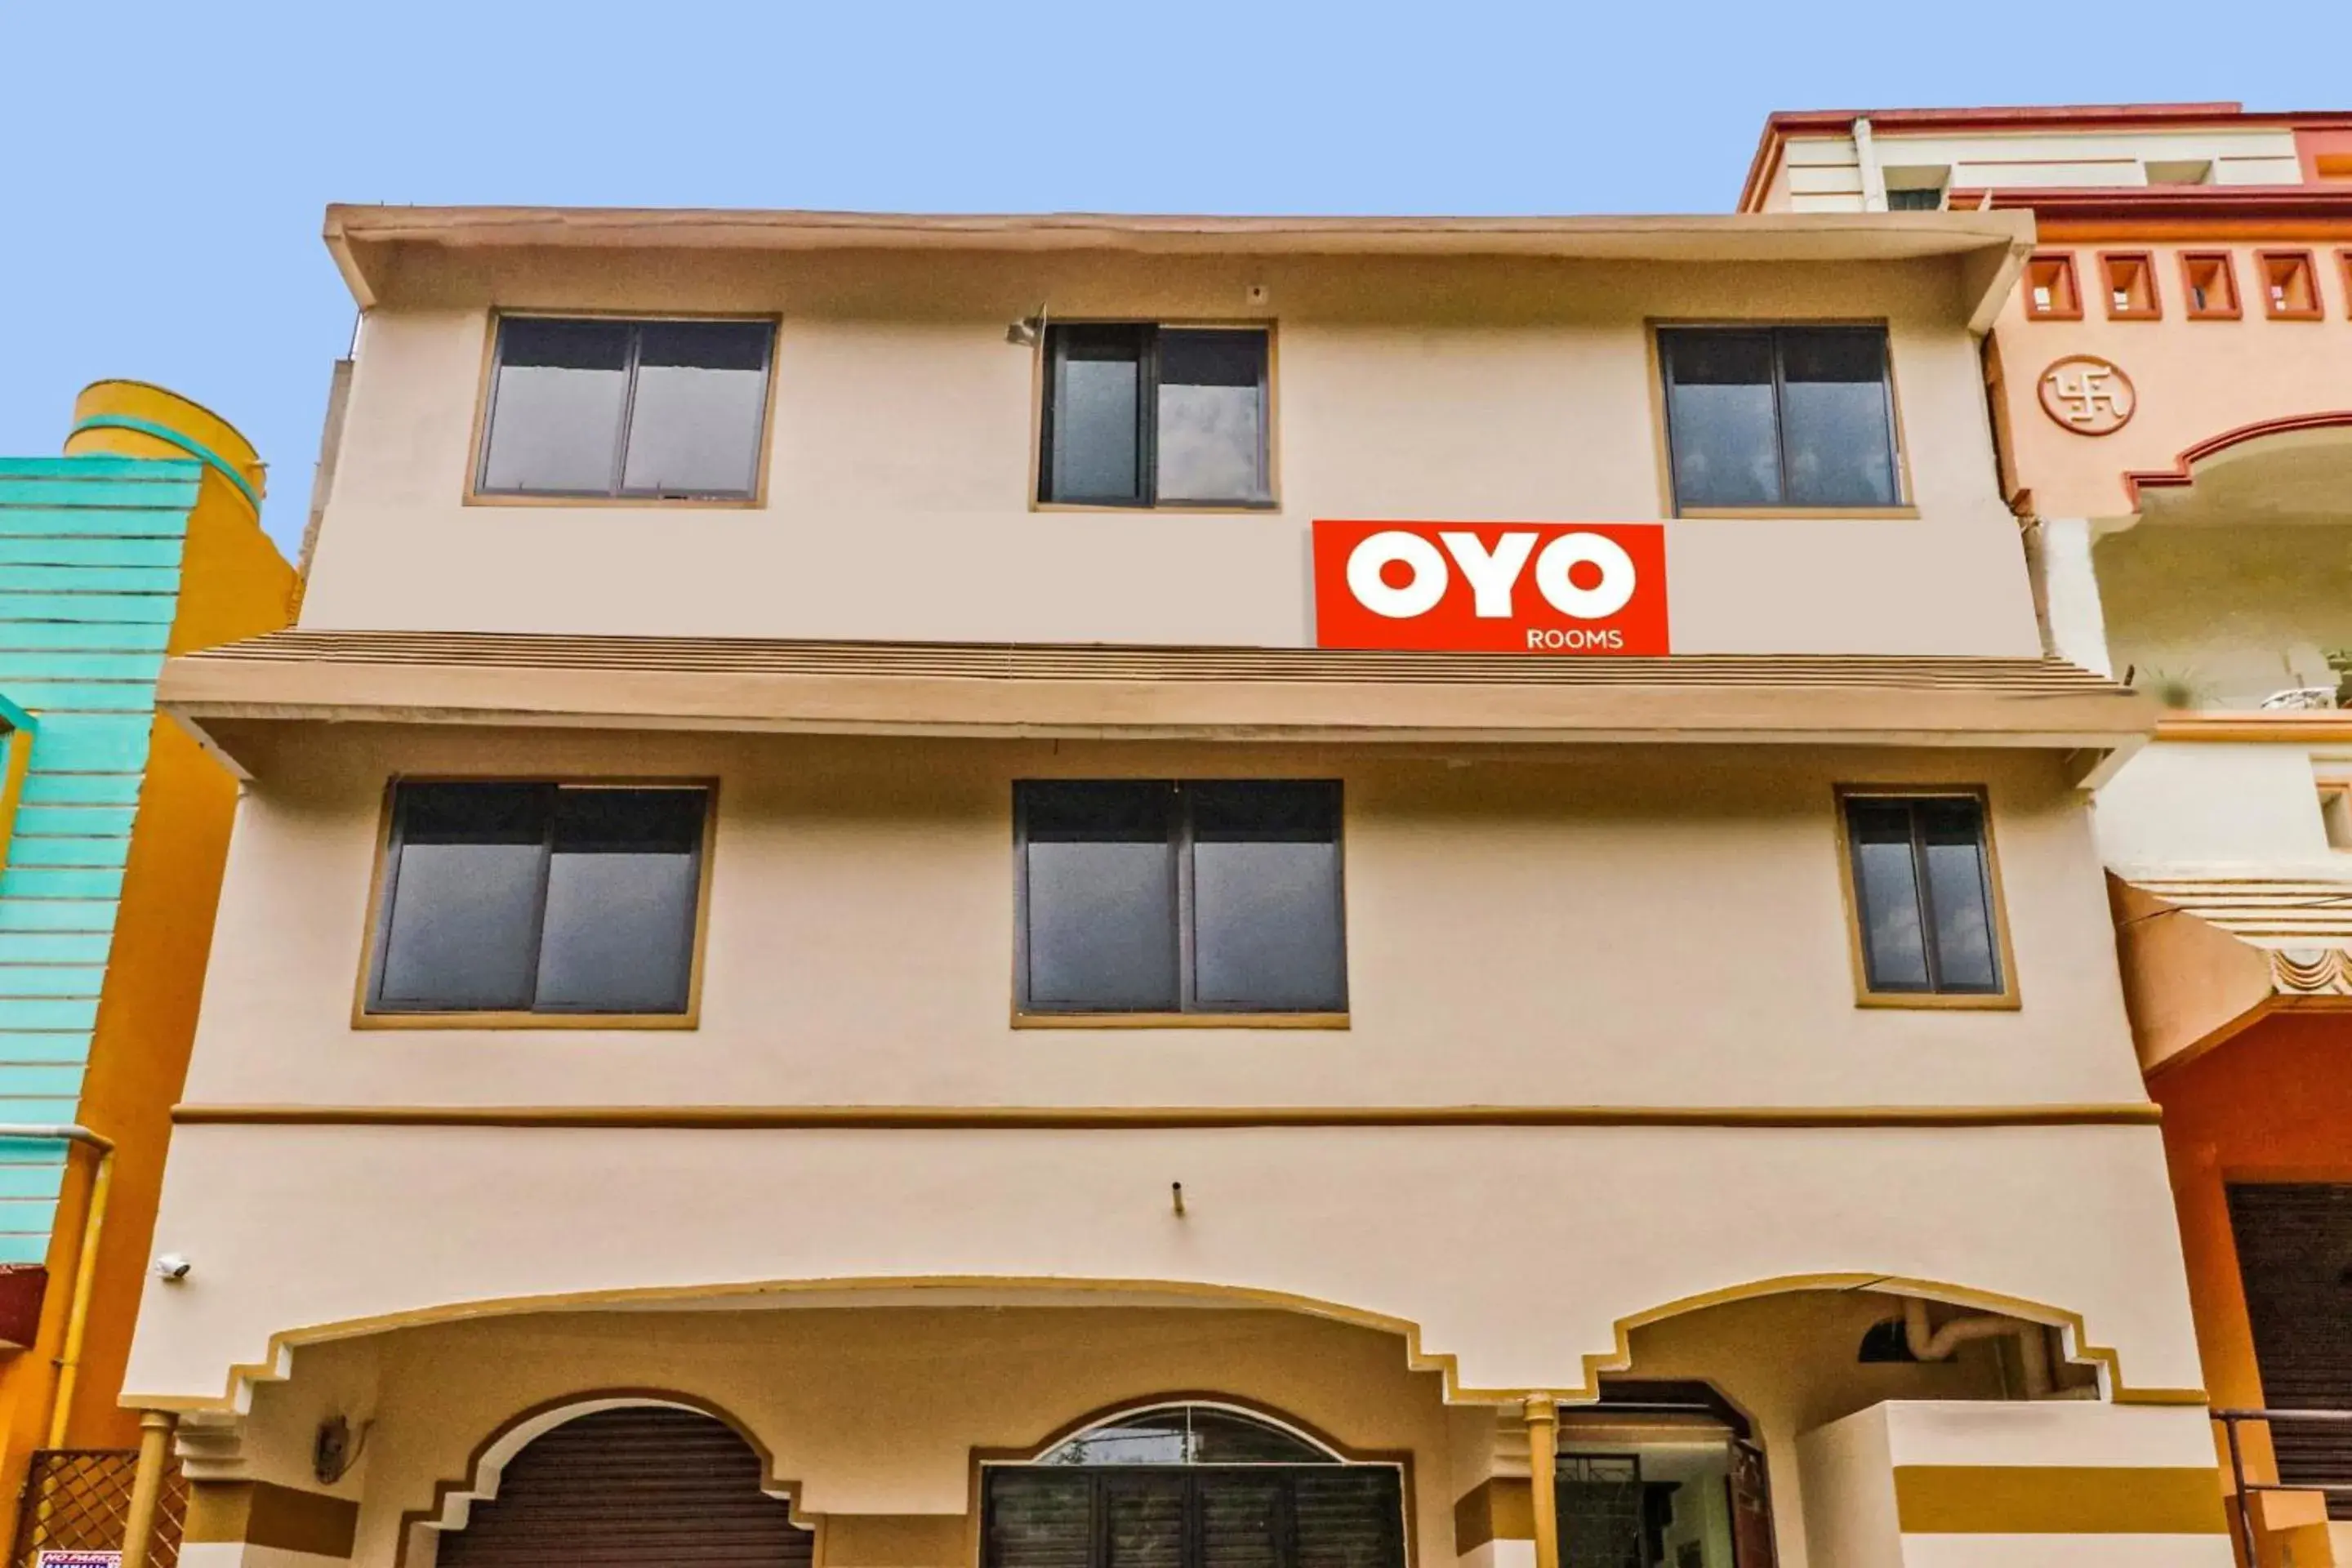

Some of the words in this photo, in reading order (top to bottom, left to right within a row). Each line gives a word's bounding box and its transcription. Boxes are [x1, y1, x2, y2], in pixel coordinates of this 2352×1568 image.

[1346, 530, 1636, 619] OYO
[1526, 628, 1624, 648] ROOMS
[43, 1553, 68, 1562] NO
[68, 1553, 122, 1562] PARKIN
